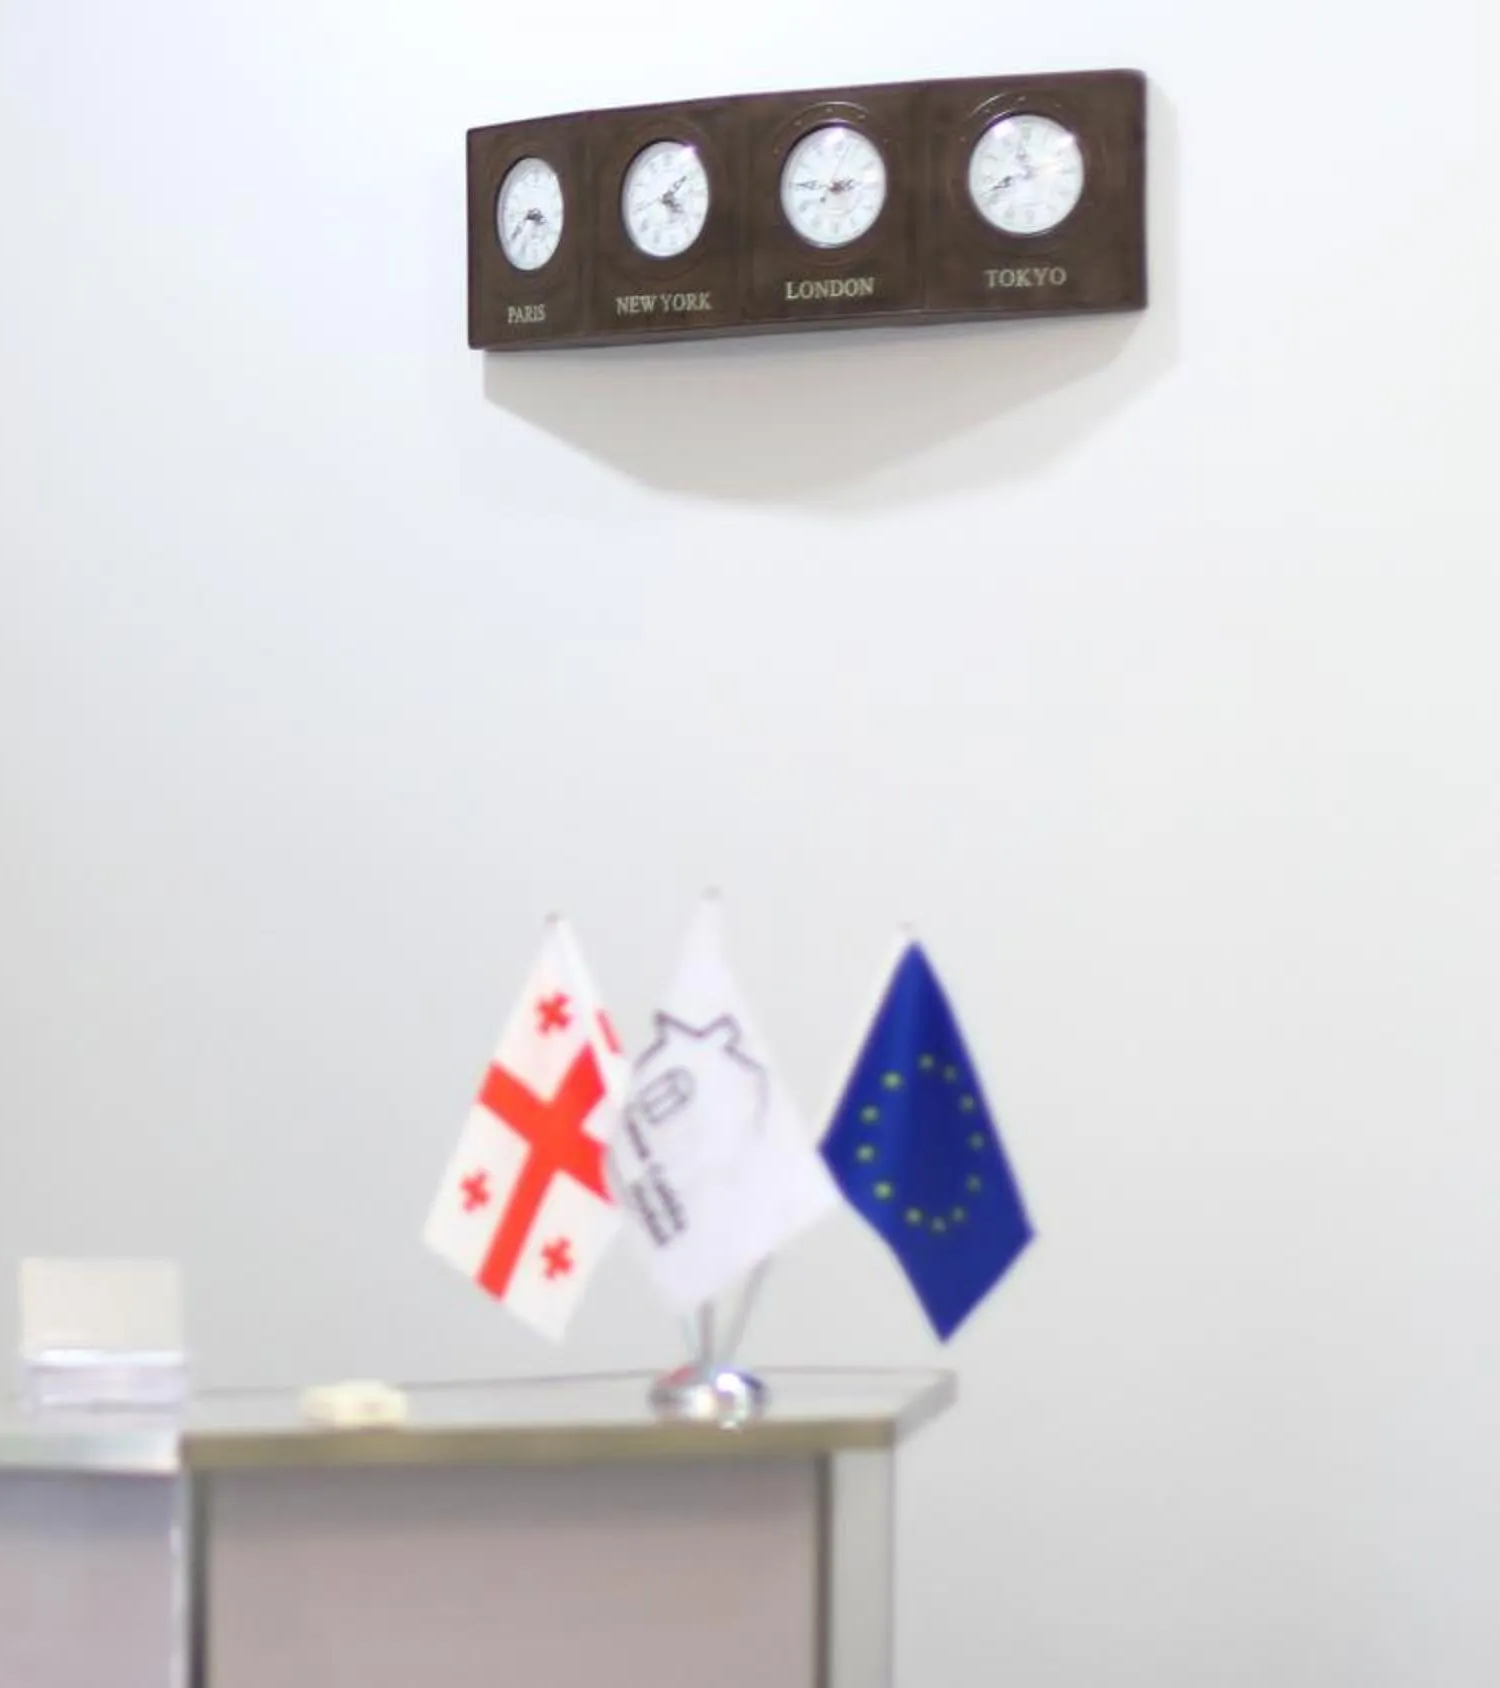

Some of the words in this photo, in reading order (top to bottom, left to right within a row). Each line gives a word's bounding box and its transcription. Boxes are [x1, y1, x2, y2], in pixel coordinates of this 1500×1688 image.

[985, 266, 1067, 288] TOKYO
[785, 277, 875, 300] LONDON
[507, 303, 546, 324] PARIS
[616, 295, 657, 315] NEW
[659, 292, 712, 312] YORK
